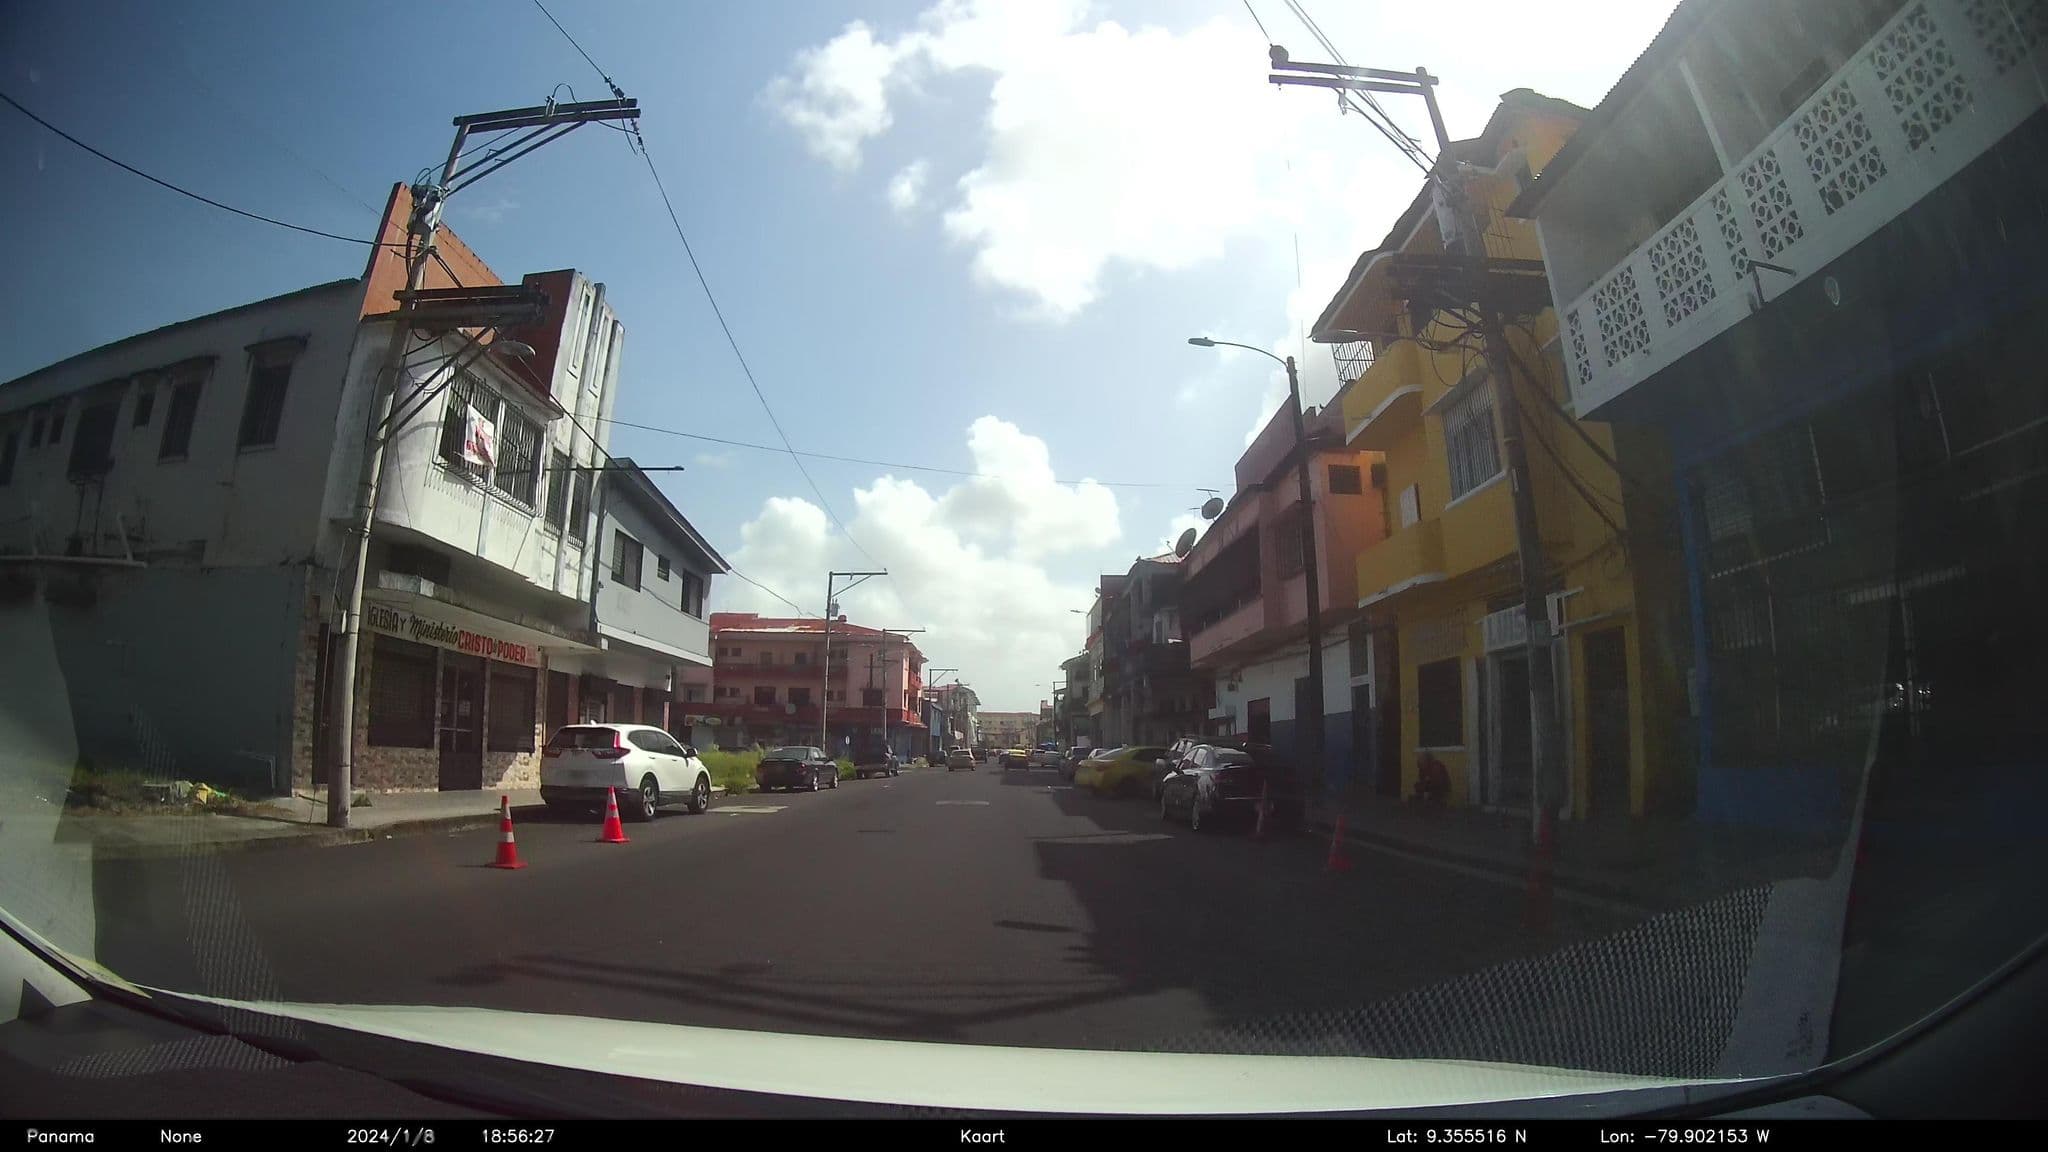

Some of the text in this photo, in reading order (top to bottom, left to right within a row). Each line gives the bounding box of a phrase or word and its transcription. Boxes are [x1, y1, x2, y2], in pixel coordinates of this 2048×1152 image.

[409, 614, 458, 645] Ministerio
[458, 629, 492, 655] CRISTO
[497, 640, 527, 663] PODER
